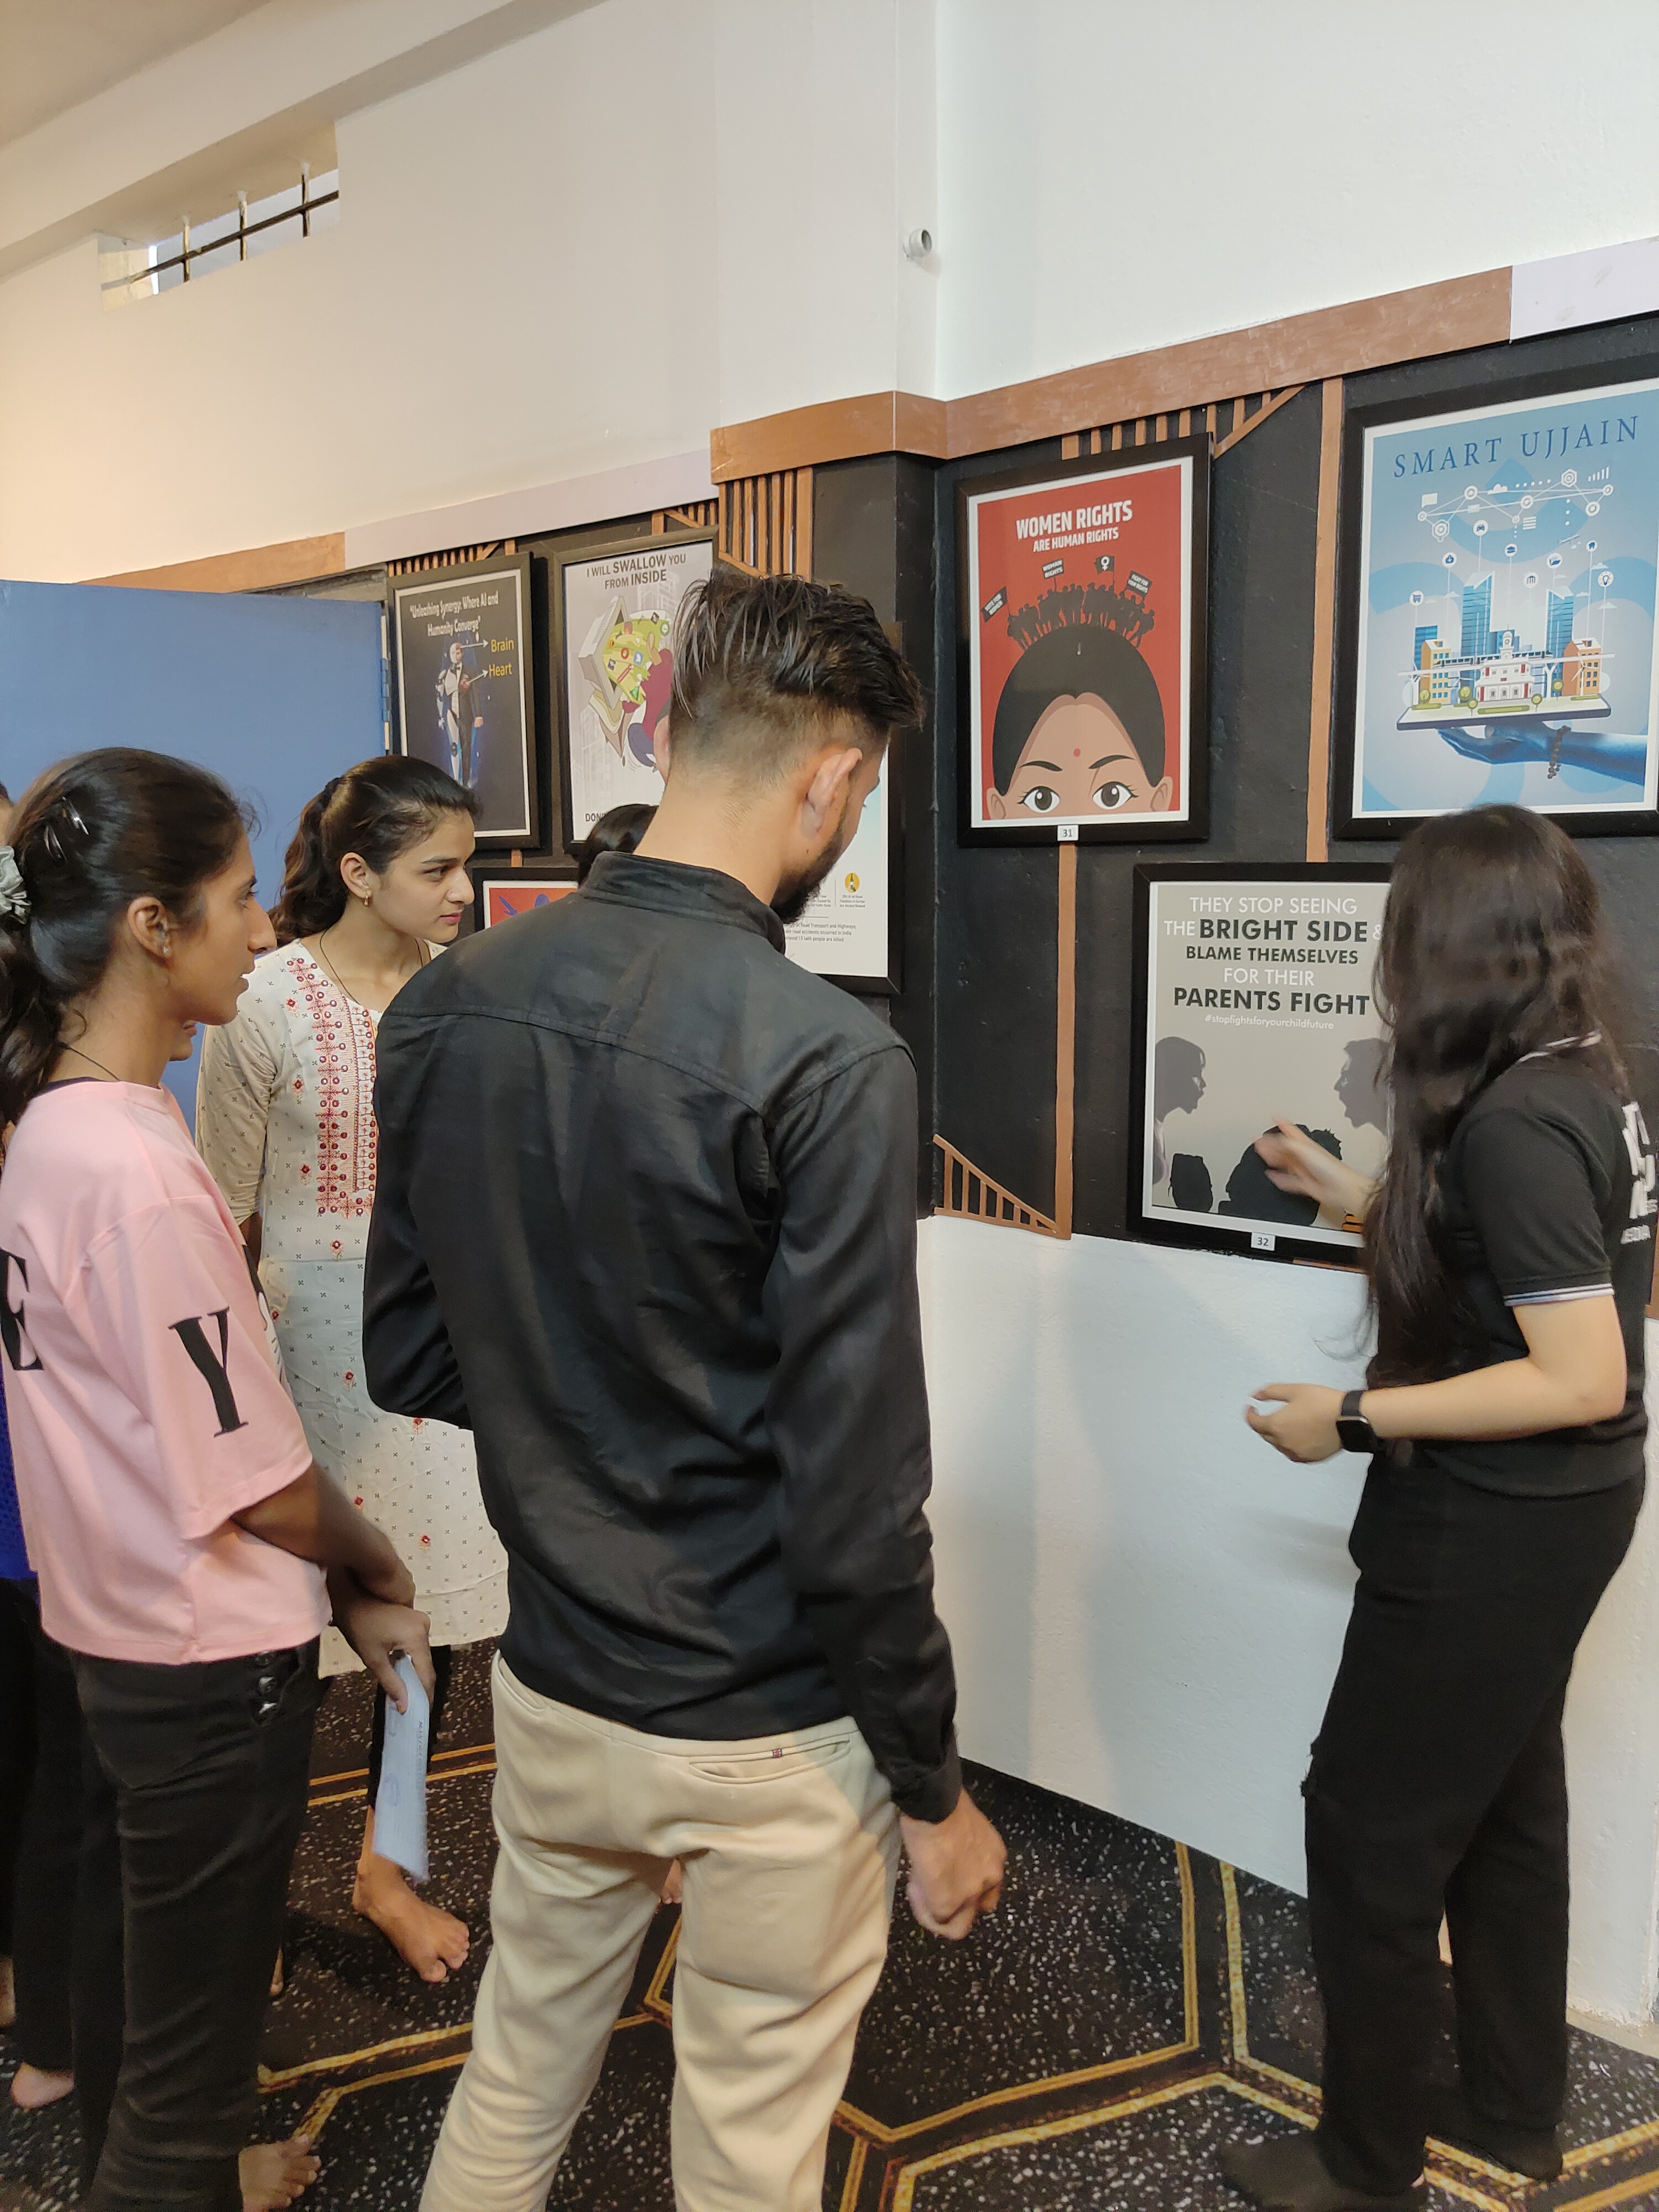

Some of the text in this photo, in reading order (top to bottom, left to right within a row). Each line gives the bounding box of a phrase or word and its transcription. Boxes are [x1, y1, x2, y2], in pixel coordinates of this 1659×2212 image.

[1393, 416, 1639, 477] SMART UJJAIN
[1016, 500, 1133, 540] WOMEN RIGHTS
[1032, 526, 1119, 552] ARE HUMAN RIGHTS
[587, 554, 686, 577] I WILL SWALLOW YOU
[605, 569, 667, 589] FROM INSIDE
[462, 596, 480, 609] Where
[481, 592, 487, 607] AI
[488, 590, 498, 605] and
[427, 621, 453, 637] Humanity
[491, 637, 514, 653] Brain
[489, 662, 512, 680] Heart
[1062, 829, 1072, 838] 31
[1190, 897, 1357, 914] THEY STOP SEEING
[1164, 921, 1195, 936] THE
[1200, 919, 1298, 941] BRIGHT
[1307, 920, 1368, 942] SIDE
[1186, 946, 1358, 964] BLAME THEMSELVES
[1224, 968, 1314, 986] FOR THEIR
[1174, 987, 1370, 1015] PARENTS FIGHT
[1205, 1014, 1334, 1030] #stopfightsforyourchildfuture
[1257, 1237, 1269, 1246] 32
